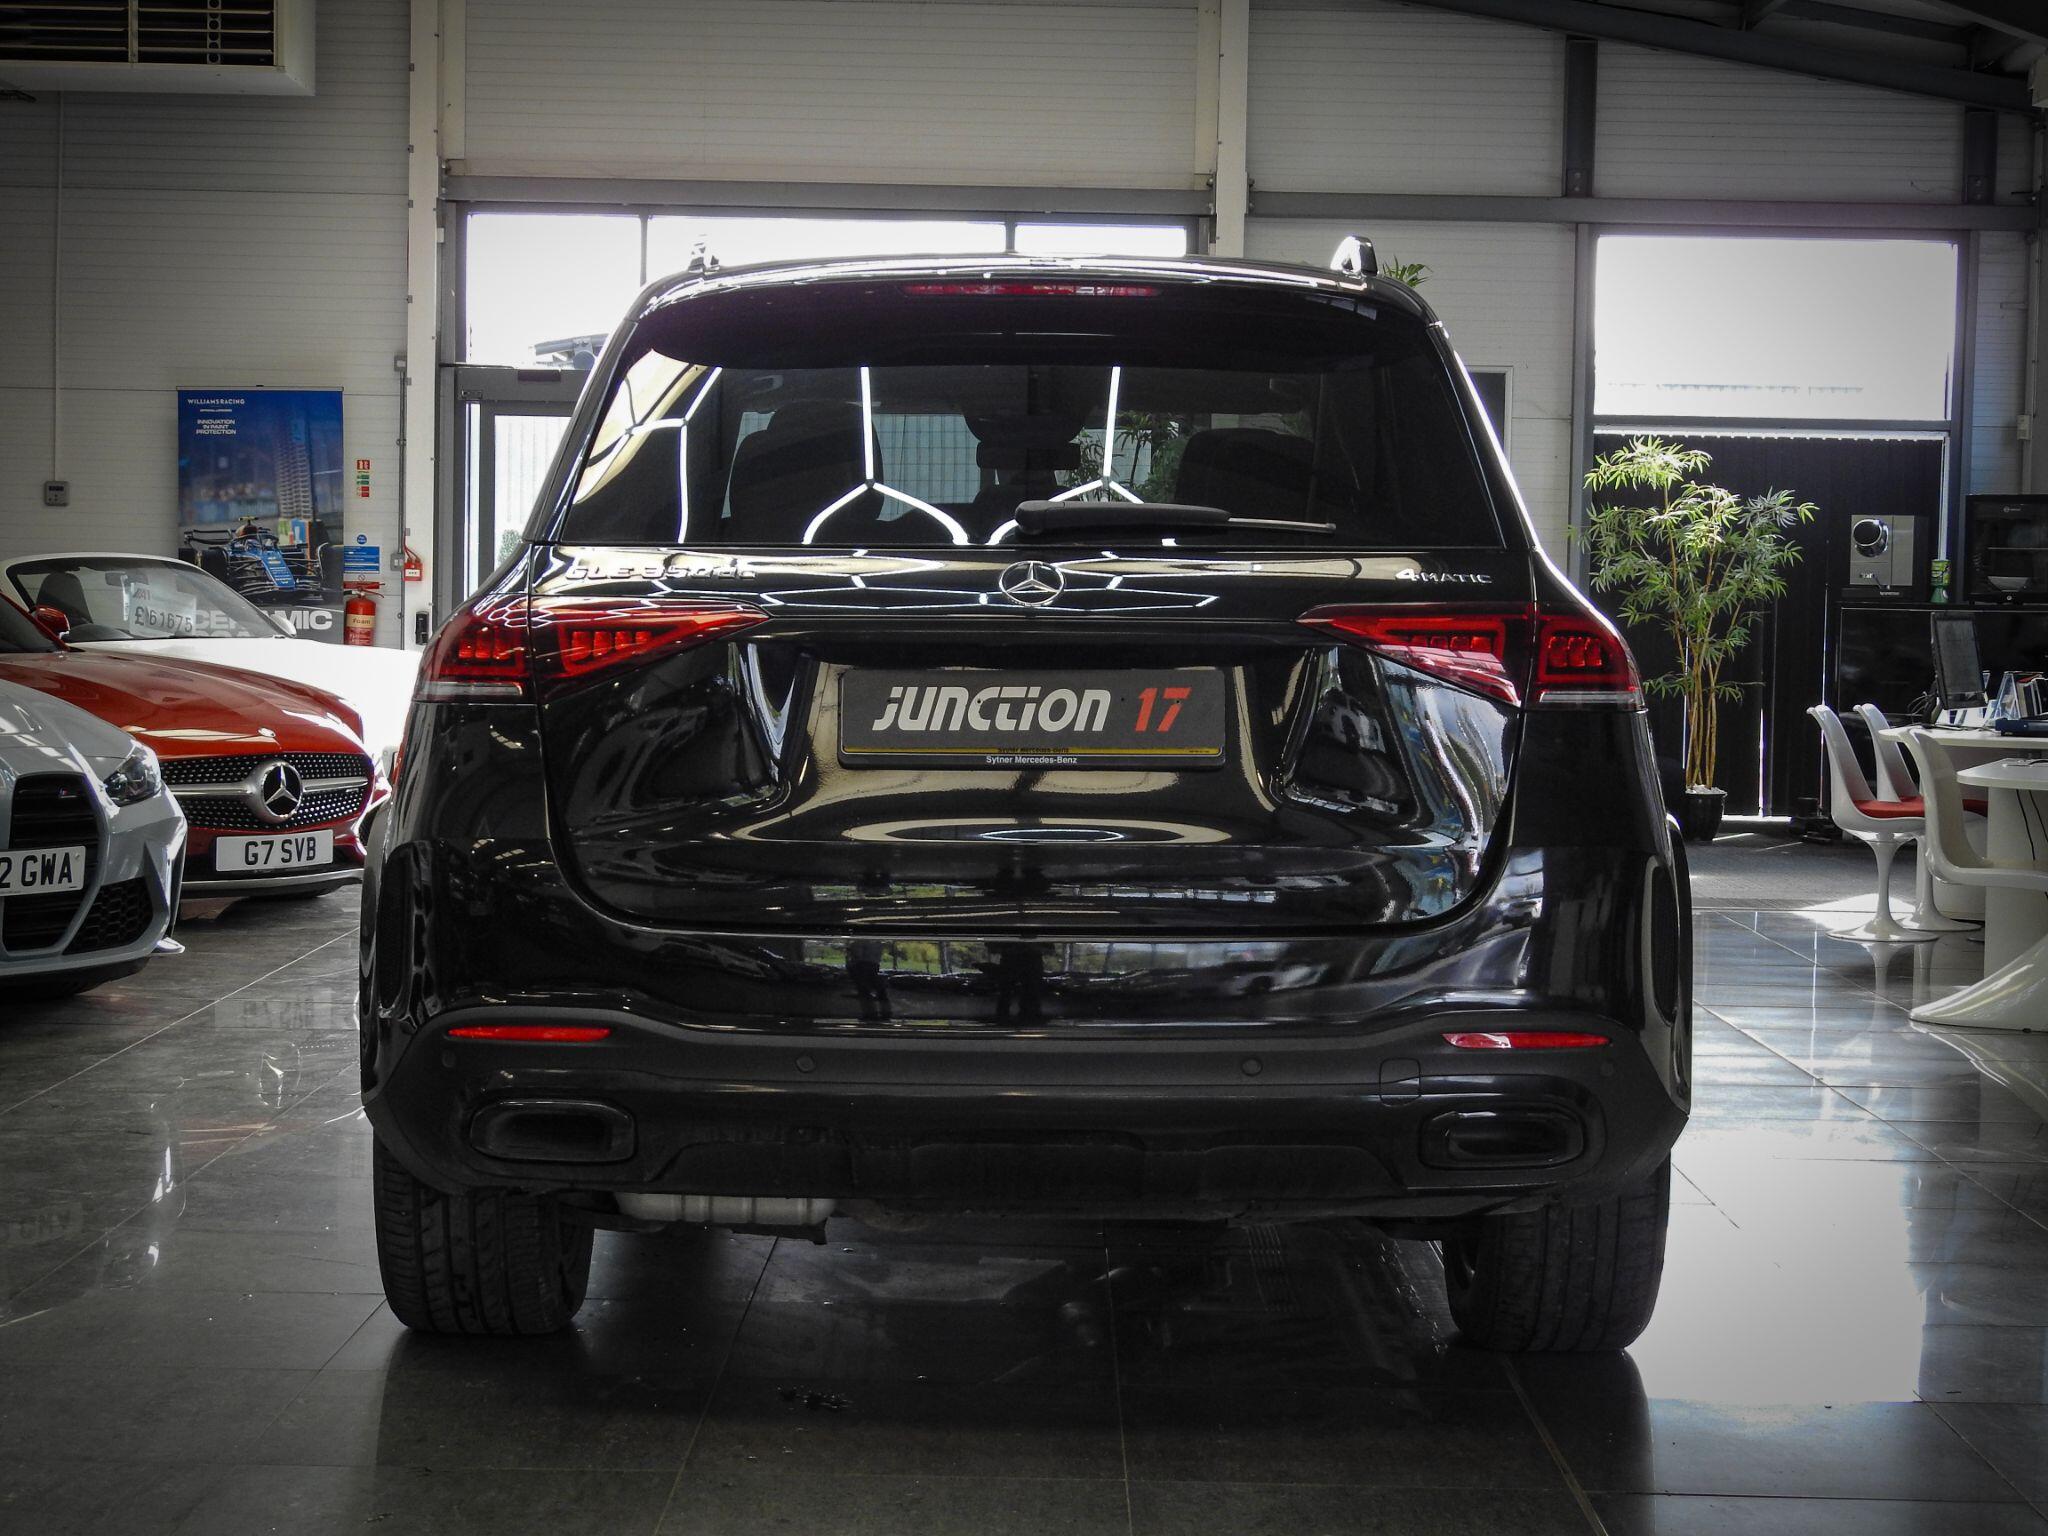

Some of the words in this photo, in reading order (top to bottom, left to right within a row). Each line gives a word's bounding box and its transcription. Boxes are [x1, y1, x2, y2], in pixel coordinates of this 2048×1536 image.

[1395, 568, 1492, 583] 4MATIC
[1135, 686, 1192, 732] 17
[986, 755, 1013, 764] Sytner
[1014, 755, 1077, 763] Mercedes-Benz
[244, 840, 273, 866] G7
[281, 836, 316, 864] SVB
[0, 856, 13, 888] 2
[21, 852, 73, 887] GWA
